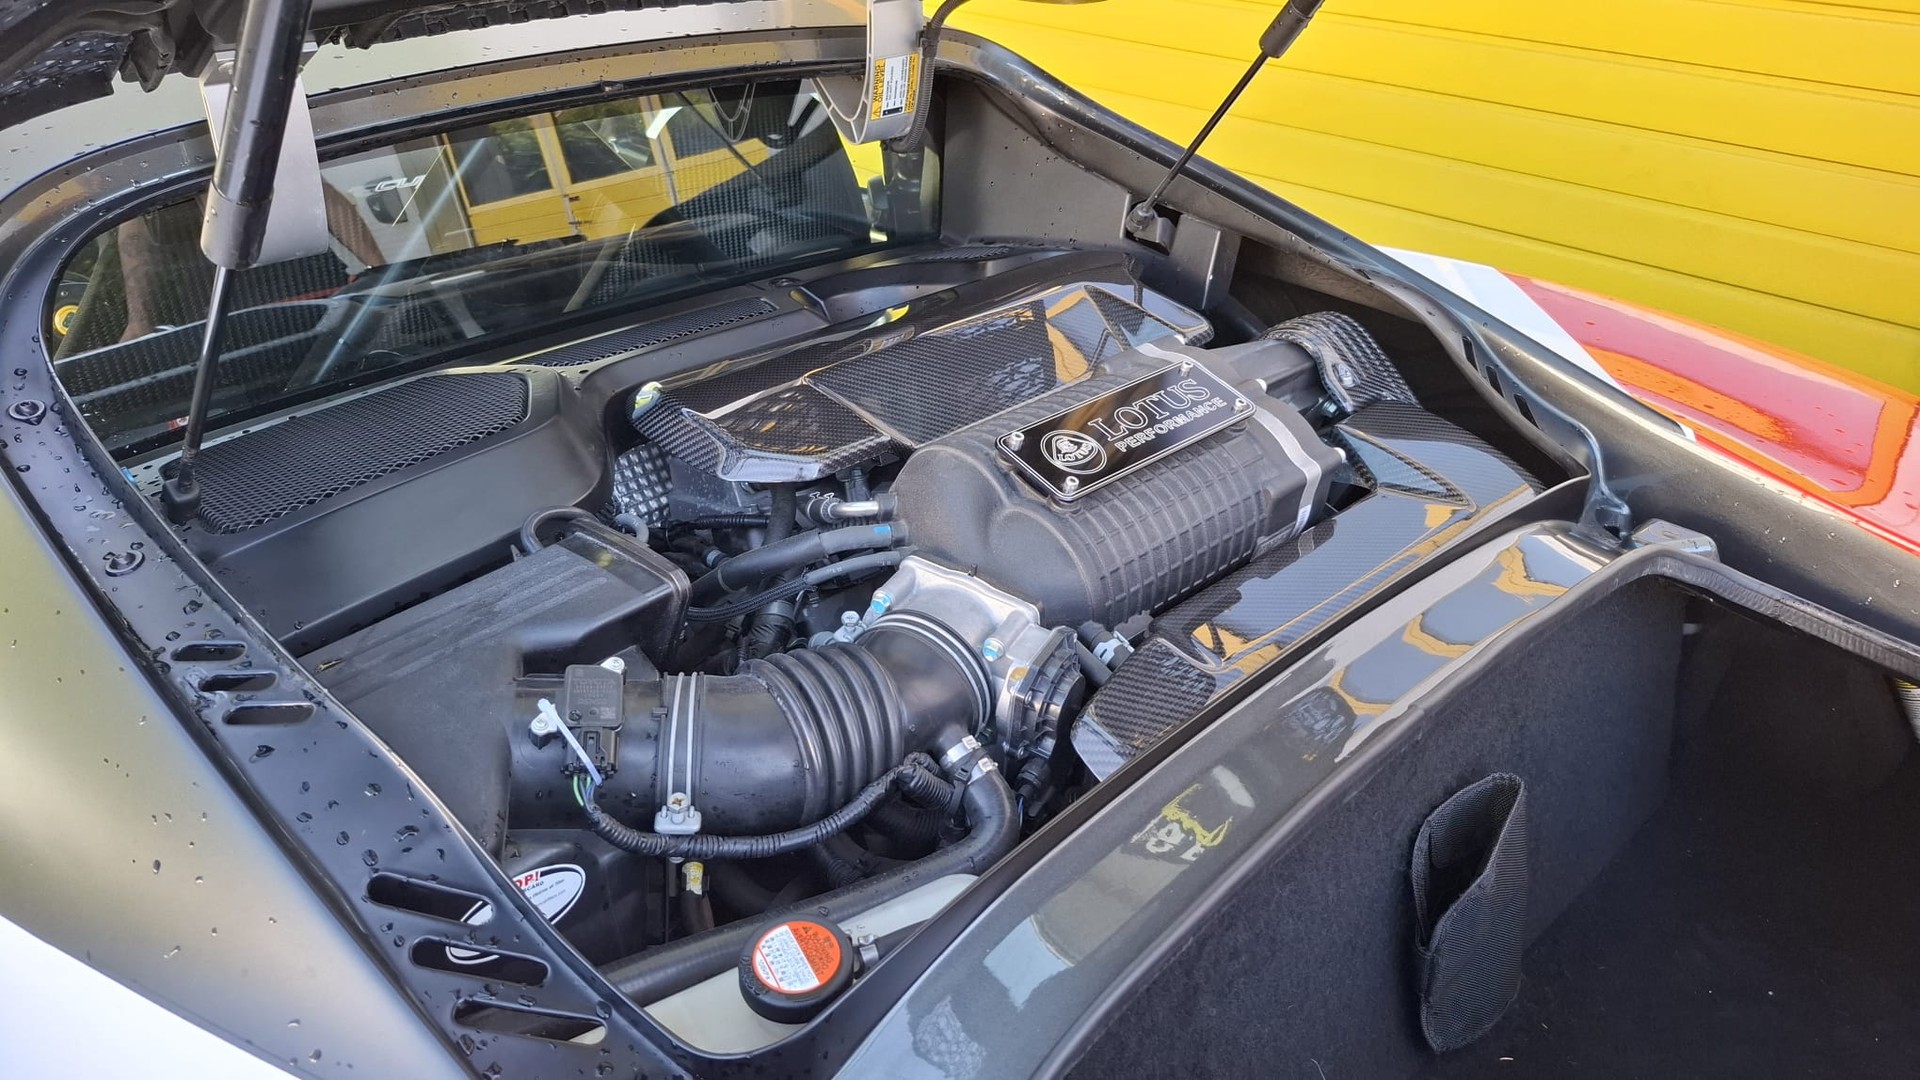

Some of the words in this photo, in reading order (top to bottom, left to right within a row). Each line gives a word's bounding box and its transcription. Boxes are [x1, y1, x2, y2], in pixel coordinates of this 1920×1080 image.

[873, 64, 881, 102] WARNING
[1088, 378, 1212, 442] LOTUS
[1114, 396, 1228, 454] PERFORMANCE
[1056, 442, 1093, 464] LOTUS
